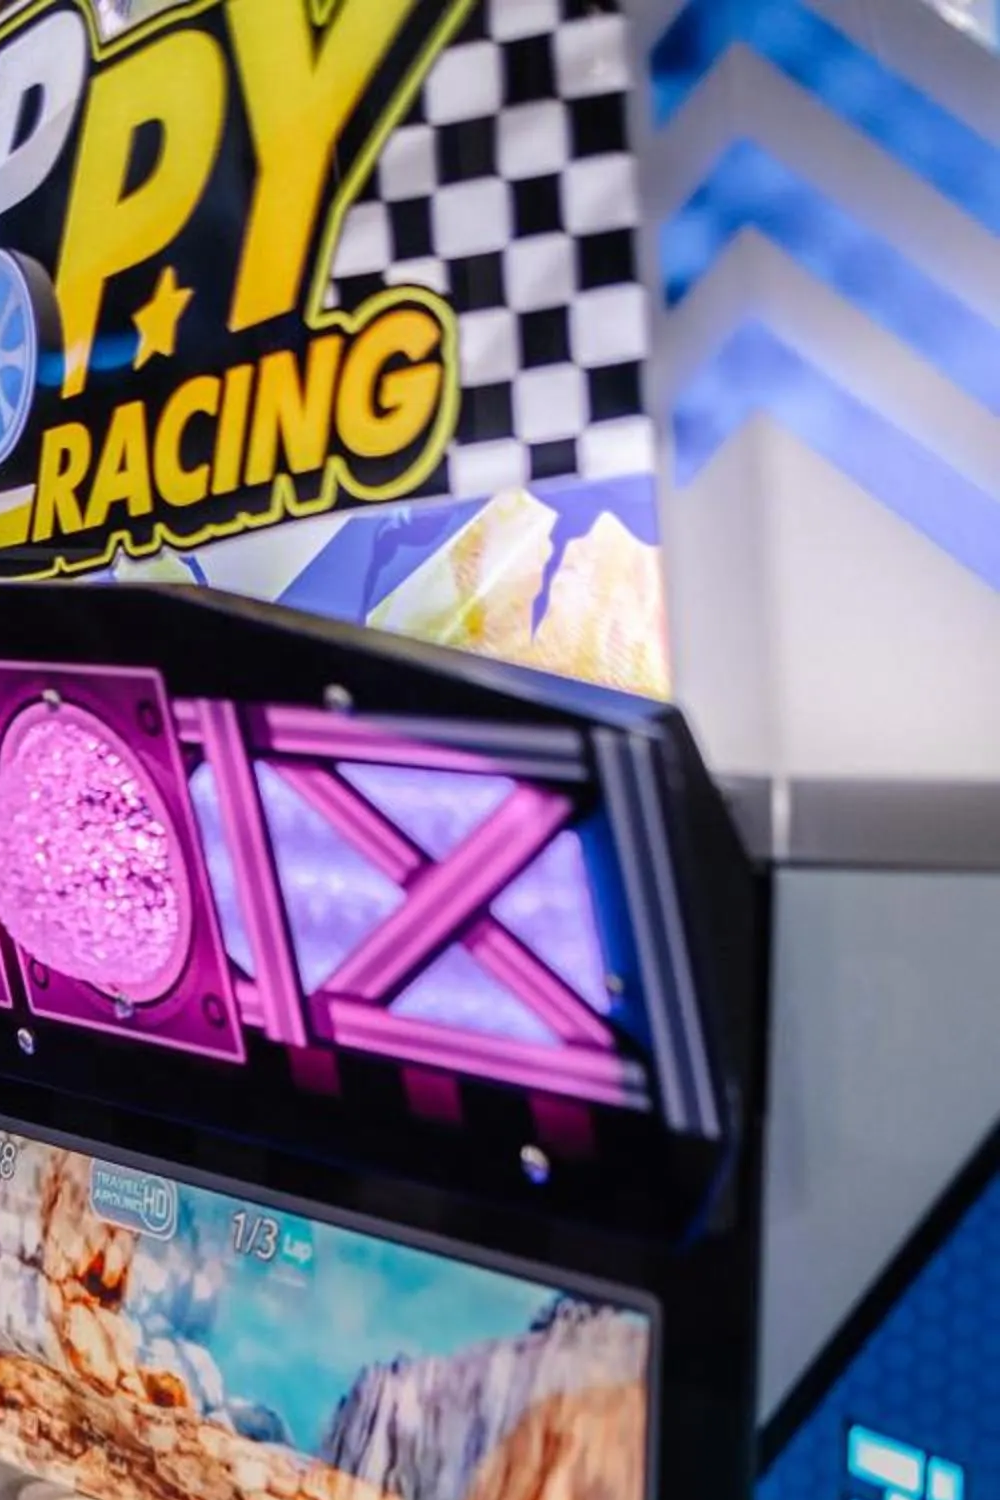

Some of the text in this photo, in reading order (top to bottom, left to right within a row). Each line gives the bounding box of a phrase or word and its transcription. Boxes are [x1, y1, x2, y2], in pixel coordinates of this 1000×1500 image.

[29, 310, 443, 543] RACING
[143, 1184, 167, 1219] HD
[233, 1212, 278, 1260] 1/3
